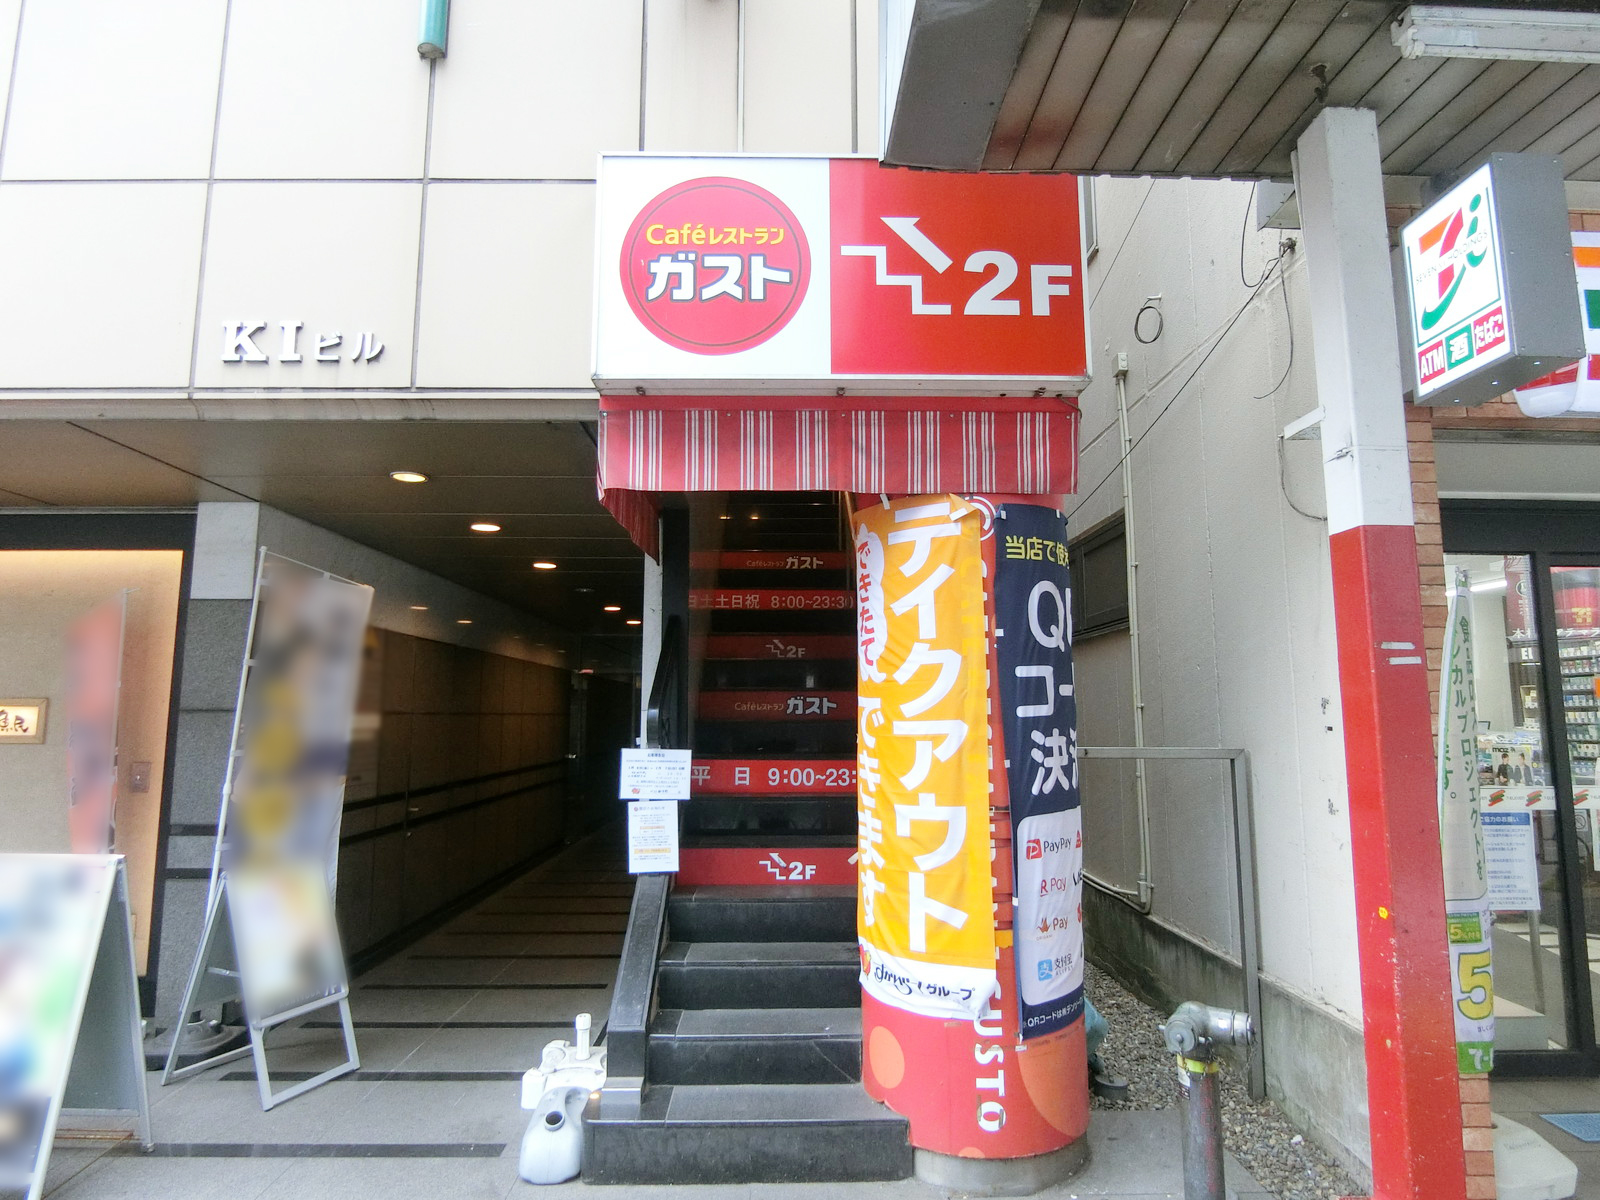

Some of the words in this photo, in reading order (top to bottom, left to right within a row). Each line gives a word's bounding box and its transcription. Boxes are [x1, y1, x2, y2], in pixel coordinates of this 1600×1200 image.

[647, 253, 792, 302] ガスト
[963, 250, 1073, 317] 2F
[1420, 350, 1446, 379] ATM
[1449, 332, 1470, 363] 酒
[1474, 313, 1504, 348] たばこ
[785, 555, 824, 570] ガスト
[786, 645, 806, 659] 2F
[786, 696, 837, 715] ガスト
[887, 501, 969, 953] テイクアウト
[857, 696, 885, 927] できます
[1043, 837, 1072, 854] PayPay
[788, 861, 817, 880] 2F
[1050, 877, 1067, 892] Pay
[1052, 916, 1069, 931] Pay
